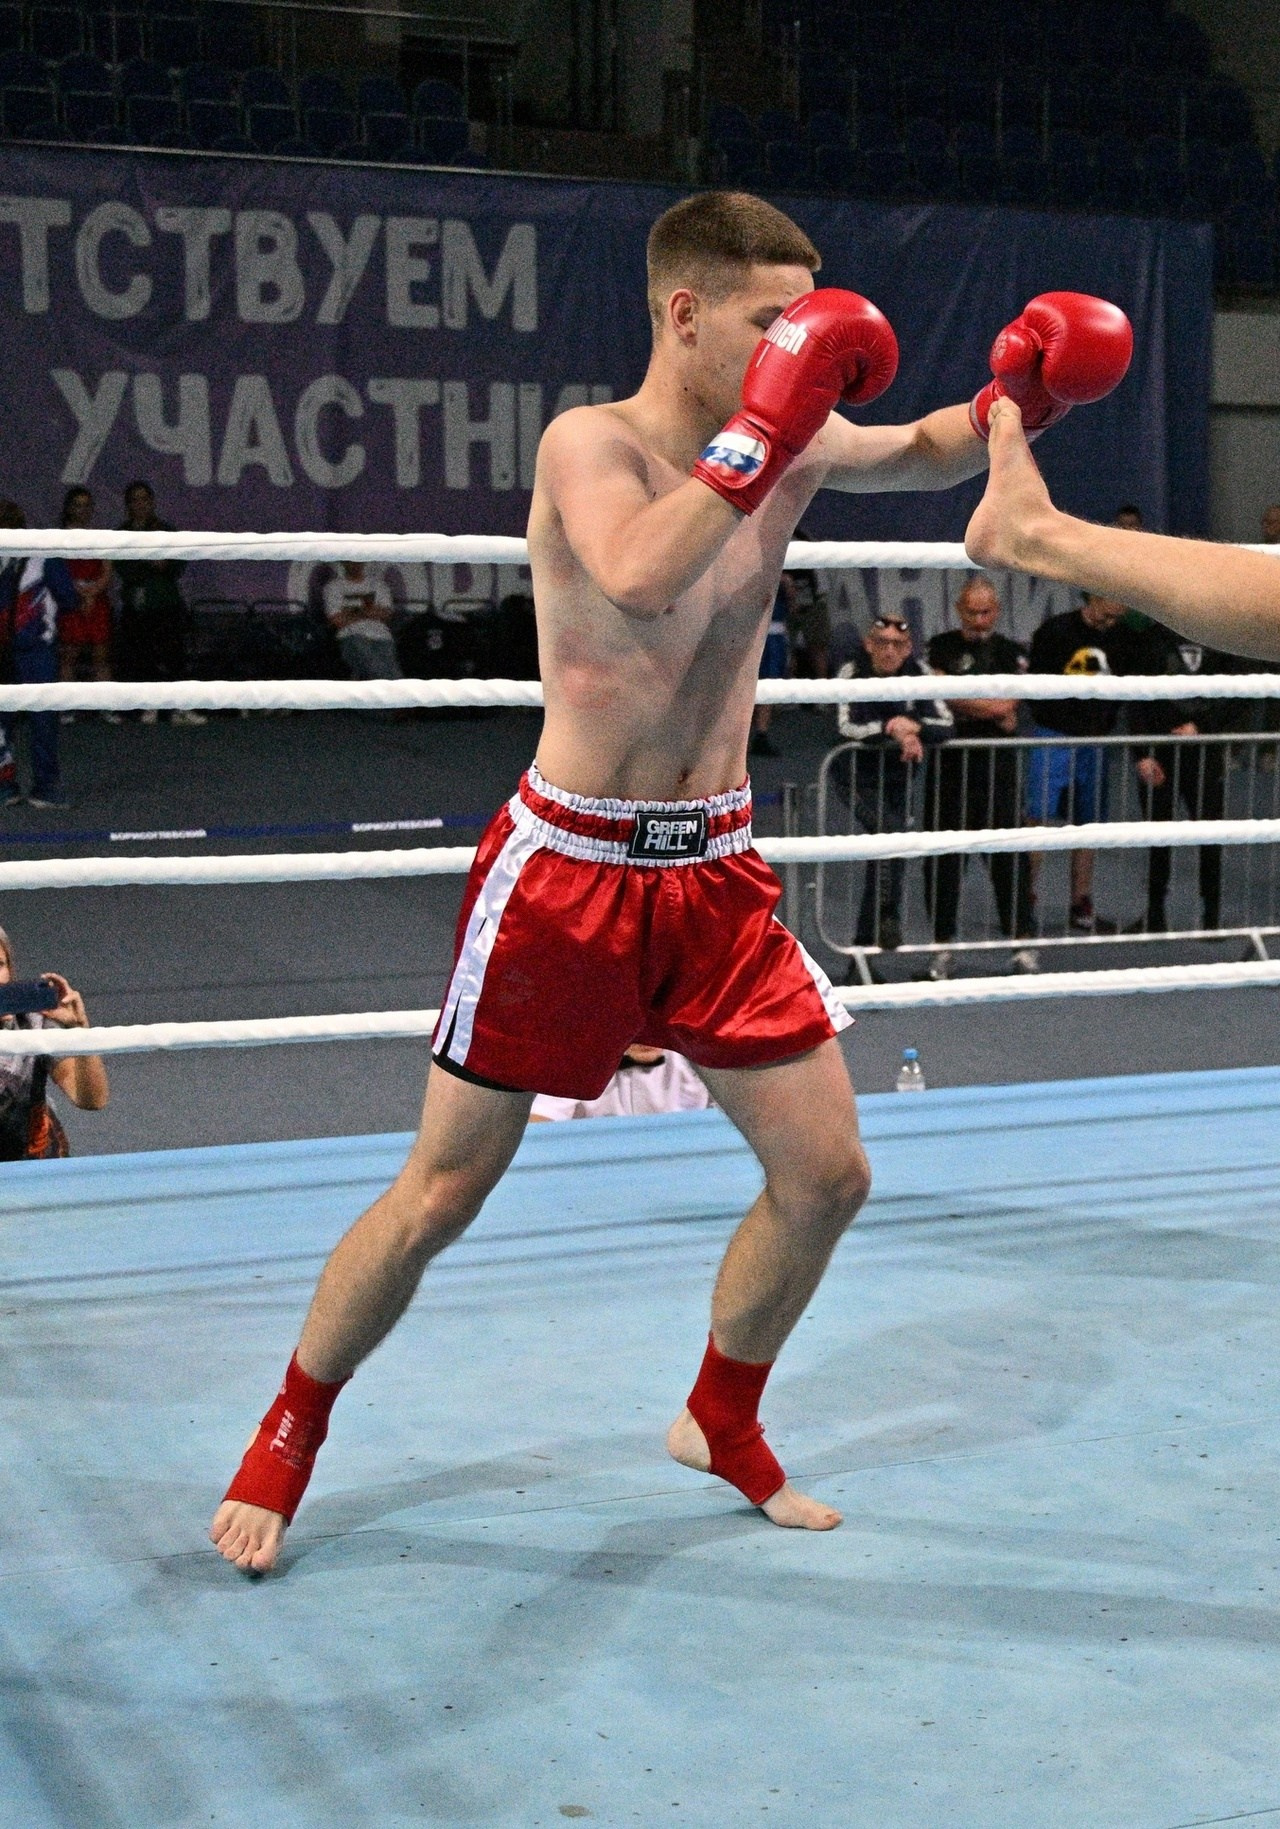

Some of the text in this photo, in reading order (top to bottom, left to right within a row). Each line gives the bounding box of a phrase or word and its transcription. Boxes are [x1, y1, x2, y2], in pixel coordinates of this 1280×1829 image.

[0, 197, 538, 331] ТСТВУЕМ
[646, 820, 698, 835] GREEN
[643, 833, 689, 851] HILL
